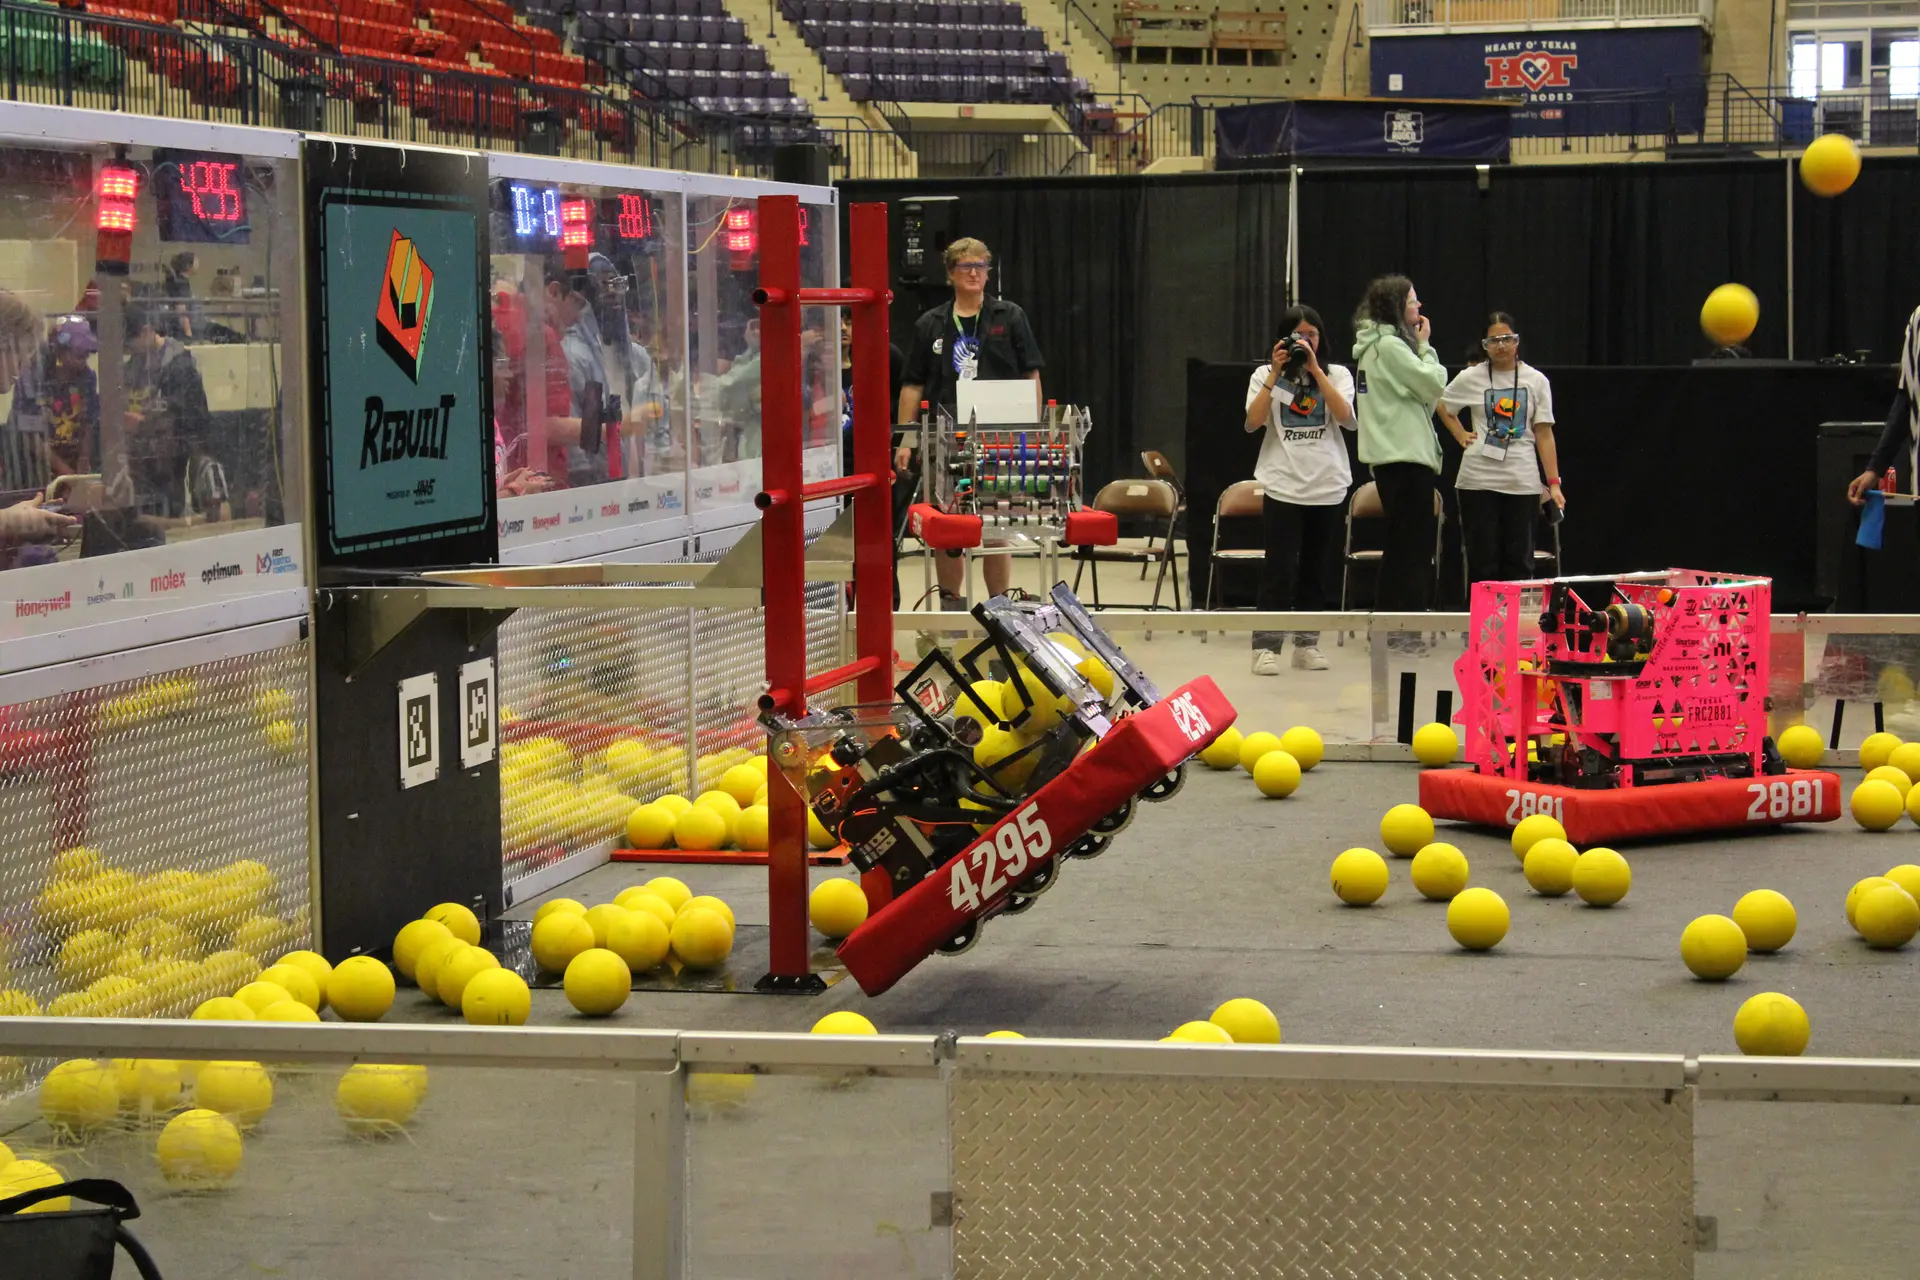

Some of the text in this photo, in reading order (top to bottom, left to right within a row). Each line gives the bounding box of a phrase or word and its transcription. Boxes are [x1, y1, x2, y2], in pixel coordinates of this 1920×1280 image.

[1485, 40, 1577, 53] HEART O' TEXAS
[1530, 92, 1574, 102] RODEO
[179, 161, 241, 220] 4295
[360, 393, 457, 470] REBUILT
[1283, 428, 1326, 442] REBUILT
[601, 500, 621, 518] molex
[508, 519, 525, 535] FIRST
[532, 512, 561, 531] Honeywell
[150, 569, 186, 593] molex
[15, 591, 71, 618] Honeywell
[87, 592, 116, 606] EMERSON
[1688, 705, 1732, 723] FRC2881
[1747, 779, 1823, 821] 2881
[946, 801, 1052, 912] 4295
